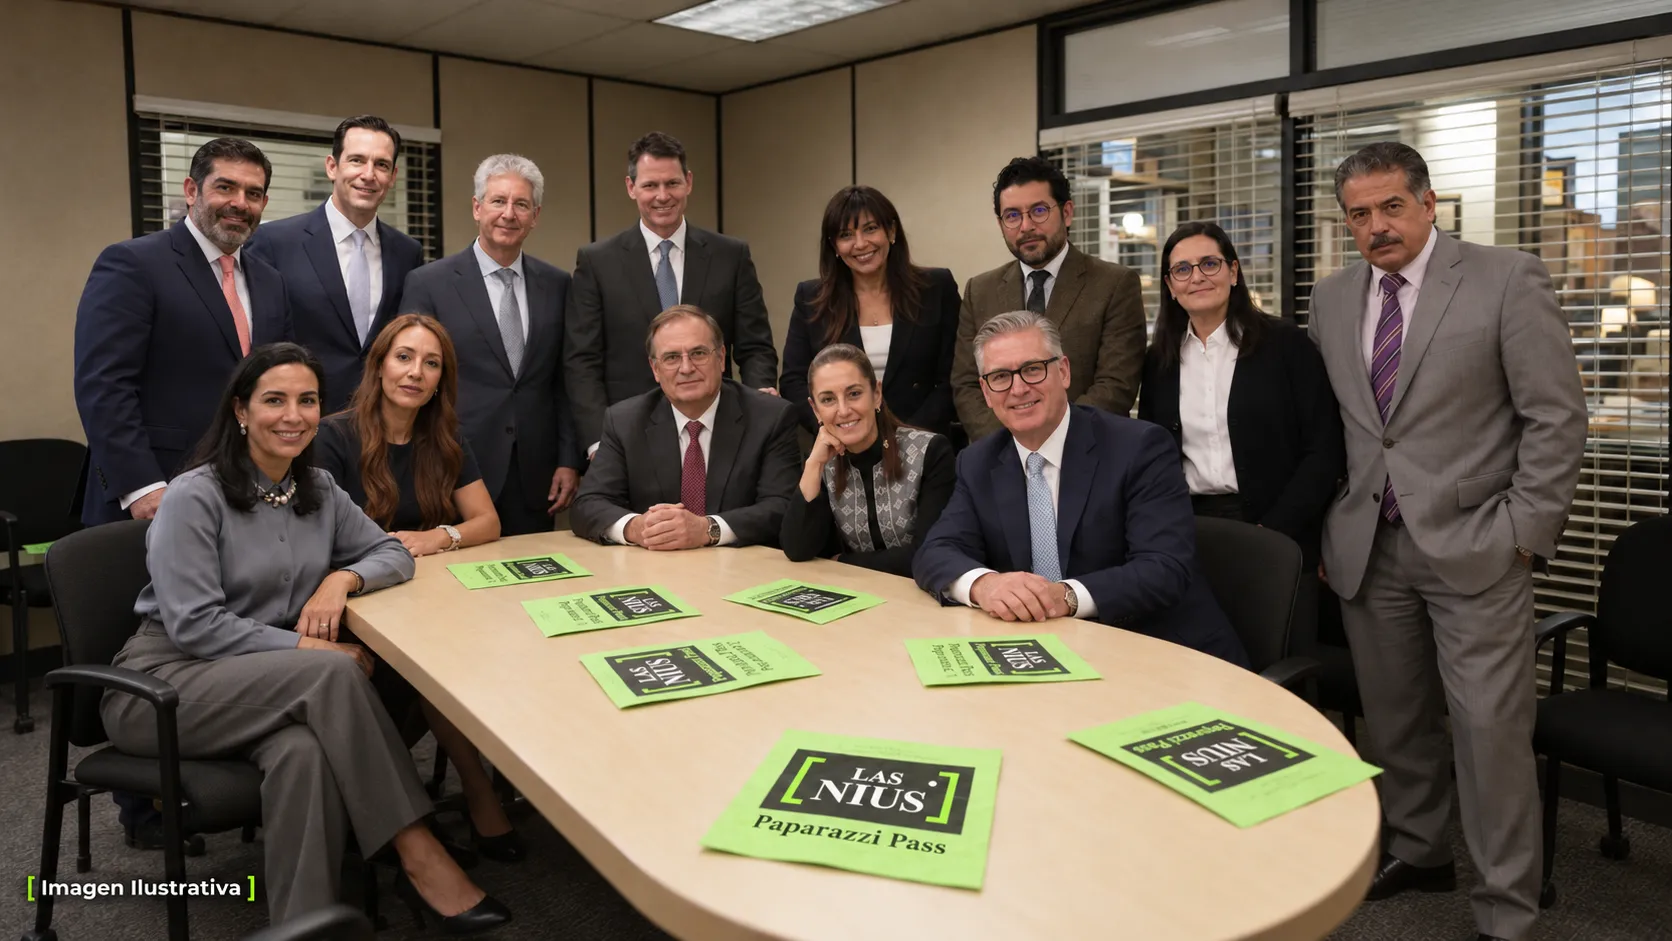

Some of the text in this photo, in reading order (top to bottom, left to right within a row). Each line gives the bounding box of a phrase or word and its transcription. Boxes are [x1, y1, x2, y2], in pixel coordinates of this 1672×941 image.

[998, 647, 1034, 669] NIUS
[1024, 651, 1047, 664] LAS
[628, 667, 657, 683] LAS
[645, 657, 692, 686] NIUS
[1181, 737, 1258, 767] NIUS
[1220, 752, 1268, 772] LAS
[851, 767, 904, 786] LAS
[810, 778, 926, 814] NIUS
[752, 814, 946, 854] Paparazzi Pass
